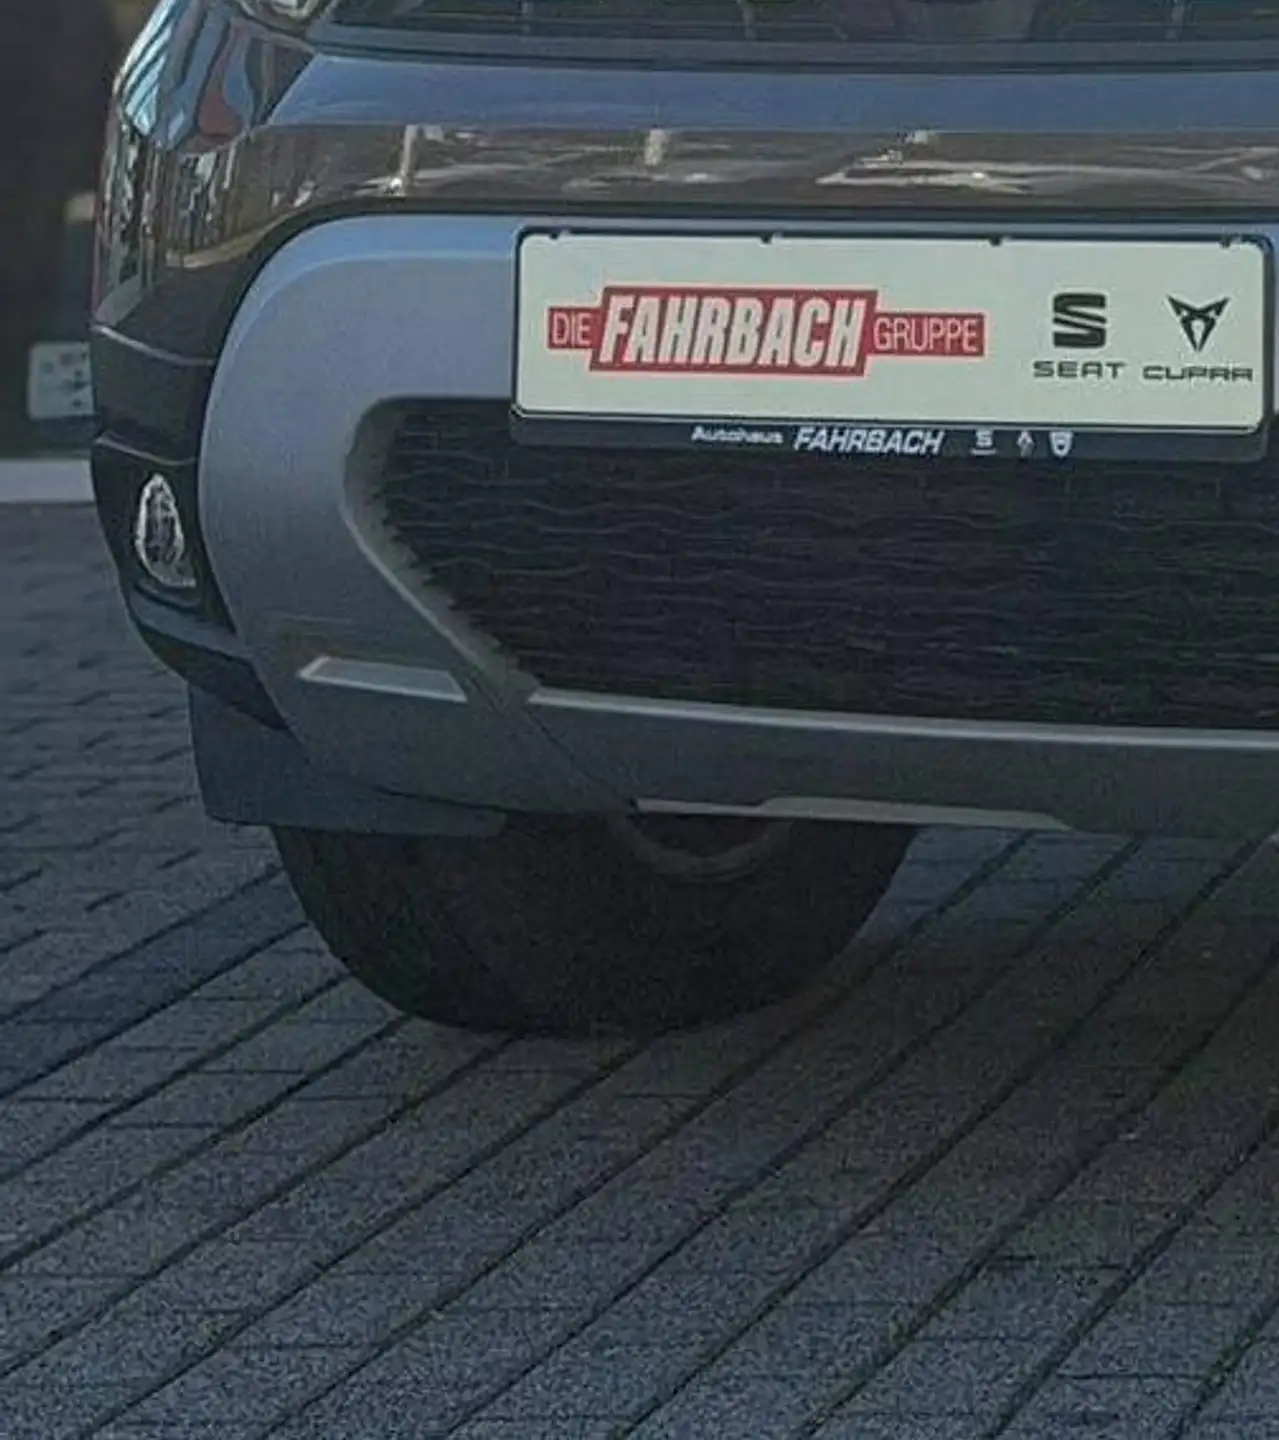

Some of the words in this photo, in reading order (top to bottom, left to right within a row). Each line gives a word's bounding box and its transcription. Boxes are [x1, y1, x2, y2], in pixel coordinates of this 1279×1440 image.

[552, 312, 592, 346] DIE
[600, 294, 867, 368] FAHRBACH
[873, 316, 979, 353] GRUPPE
[1032, 360, 1127, 379] SEAT
[1142, 365, 1254, 382] CUPRA
[691, 425, 784, 445] Autohaus
[793, 426, 945, 456] FAHRBACH
